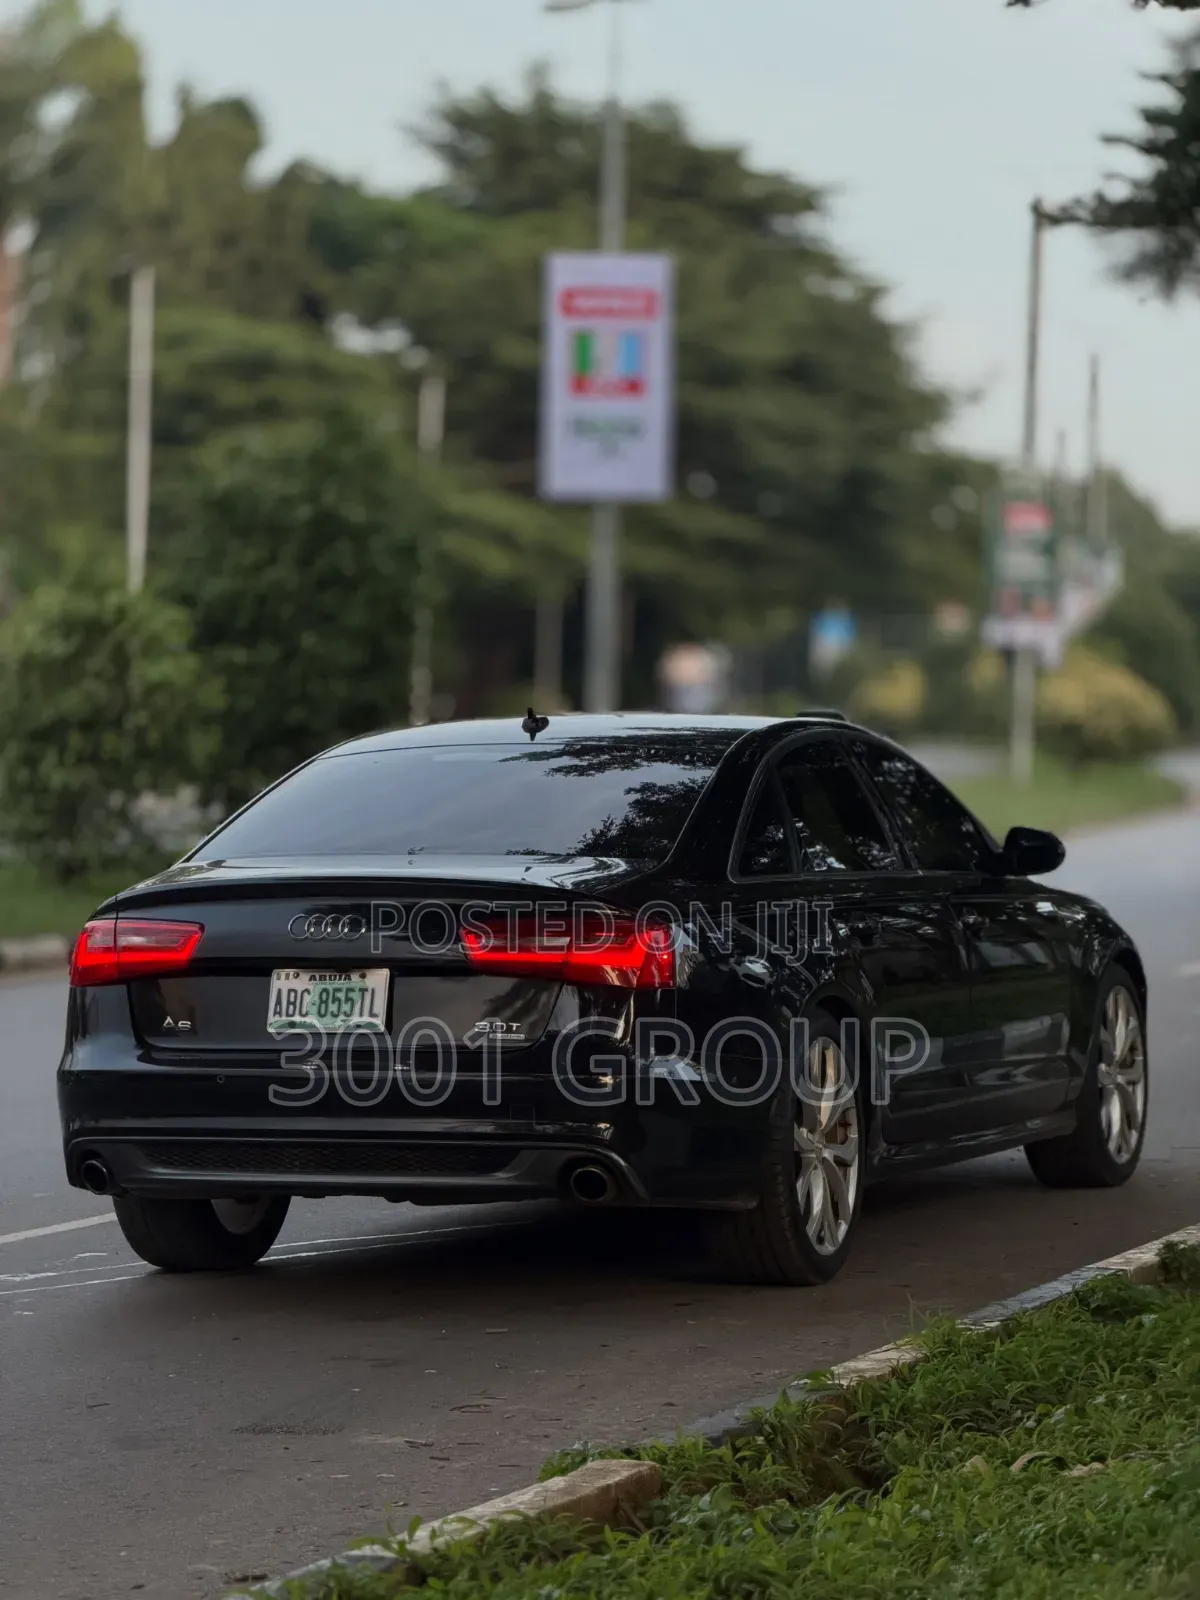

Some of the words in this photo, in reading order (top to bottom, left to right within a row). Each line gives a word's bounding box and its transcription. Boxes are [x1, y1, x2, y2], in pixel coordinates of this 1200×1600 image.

[308, 973, 352, 982] ABUJA
[272, 987, 380, 1018] ABC-855TL
[162, 1015, 192, 1031] A6
